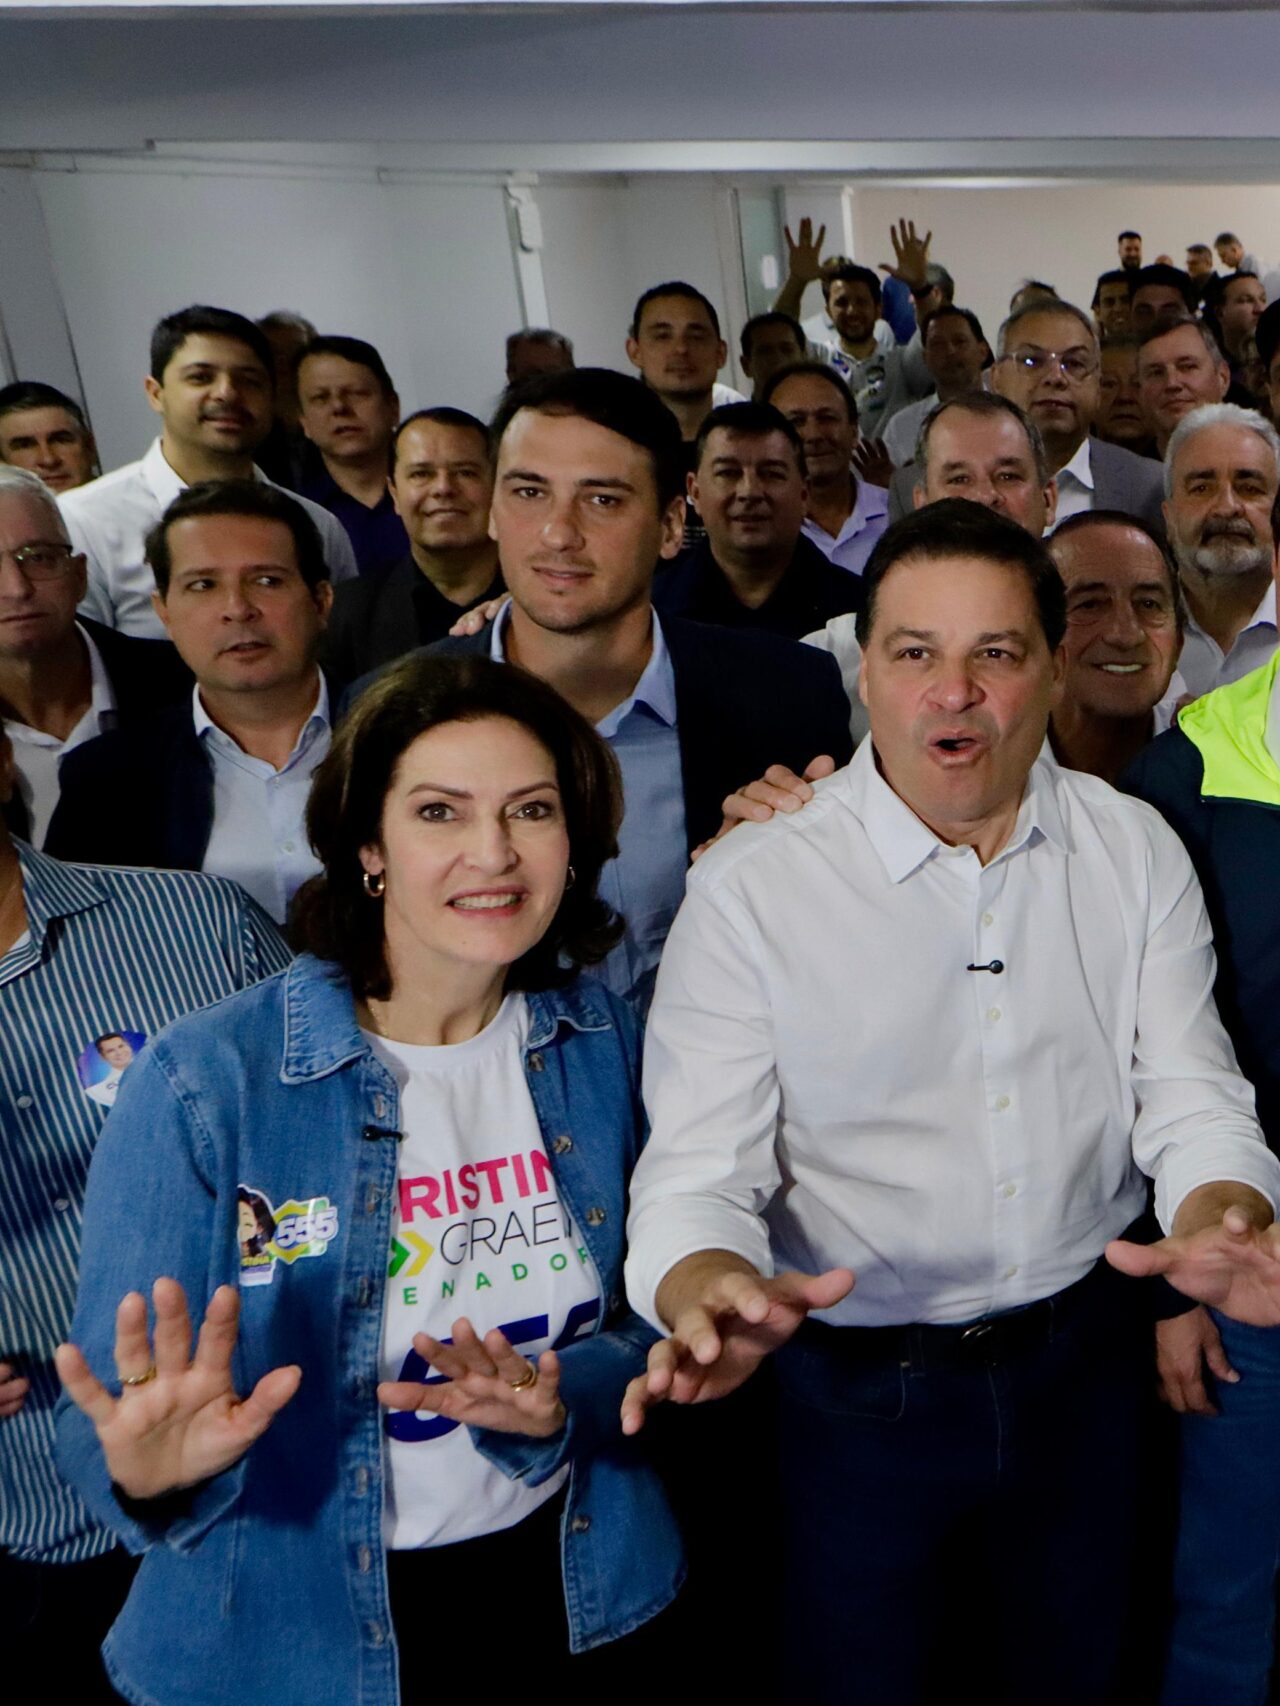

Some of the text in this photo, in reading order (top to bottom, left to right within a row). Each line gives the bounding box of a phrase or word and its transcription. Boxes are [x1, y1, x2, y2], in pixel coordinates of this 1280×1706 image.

[393, 1150, 552, 1223] RISTIN
[277, 1207, 338, 1249] 555
[440, 1201, 573, 1265] GRAE
[403, 1247, 588, 1305] ENADO
